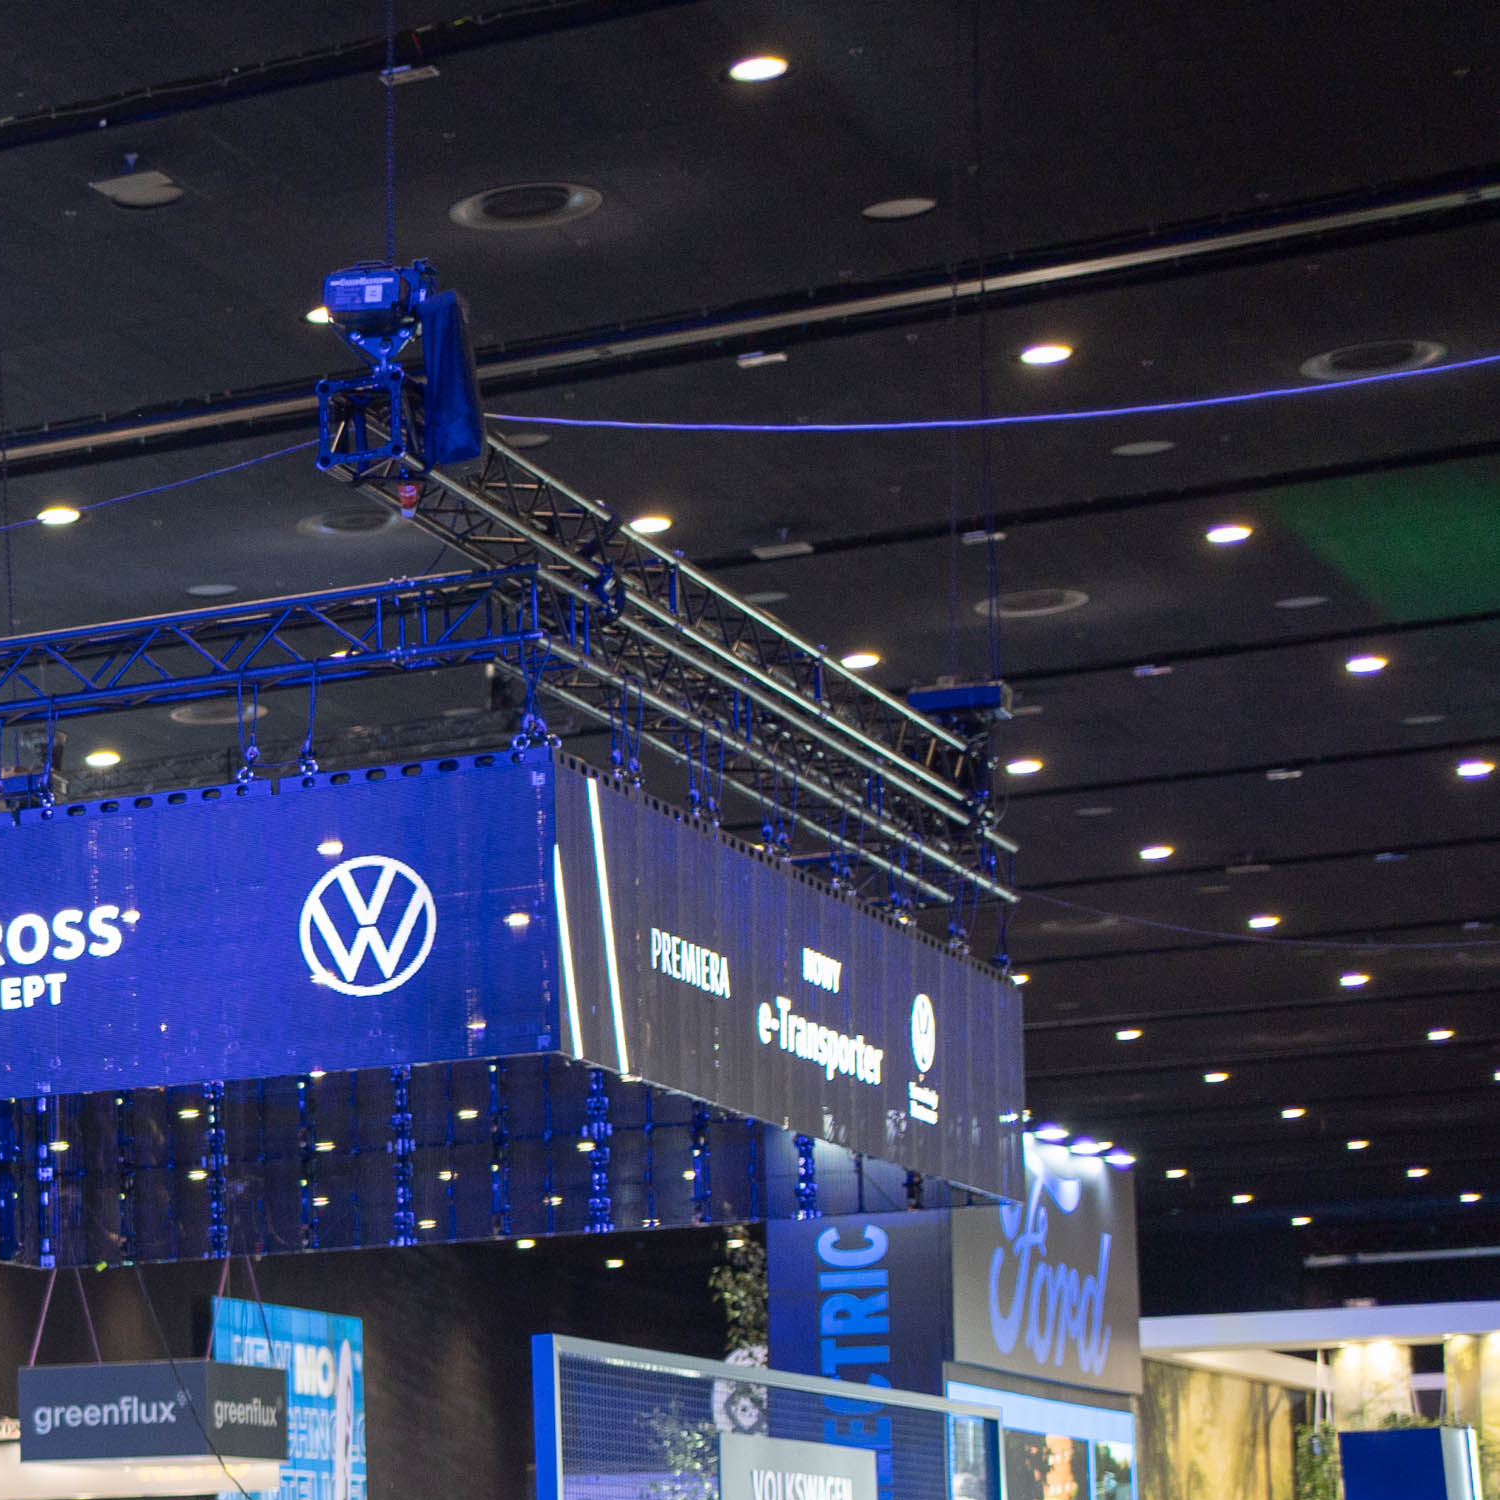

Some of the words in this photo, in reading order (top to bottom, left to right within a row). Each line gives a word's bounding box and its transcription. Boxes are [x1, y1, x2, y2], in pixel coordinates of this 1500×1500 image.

[651, 927, 731, 999] PREMIERA
[802, 947, 842, 993] NOWY
[758, 996, 883, 1085] e-Transporter
[988, 1175, 1113, 1376] Ford
[33, 1394, 177, 1435] greenflux
[214, 1397, 278, 1428] greenflux
